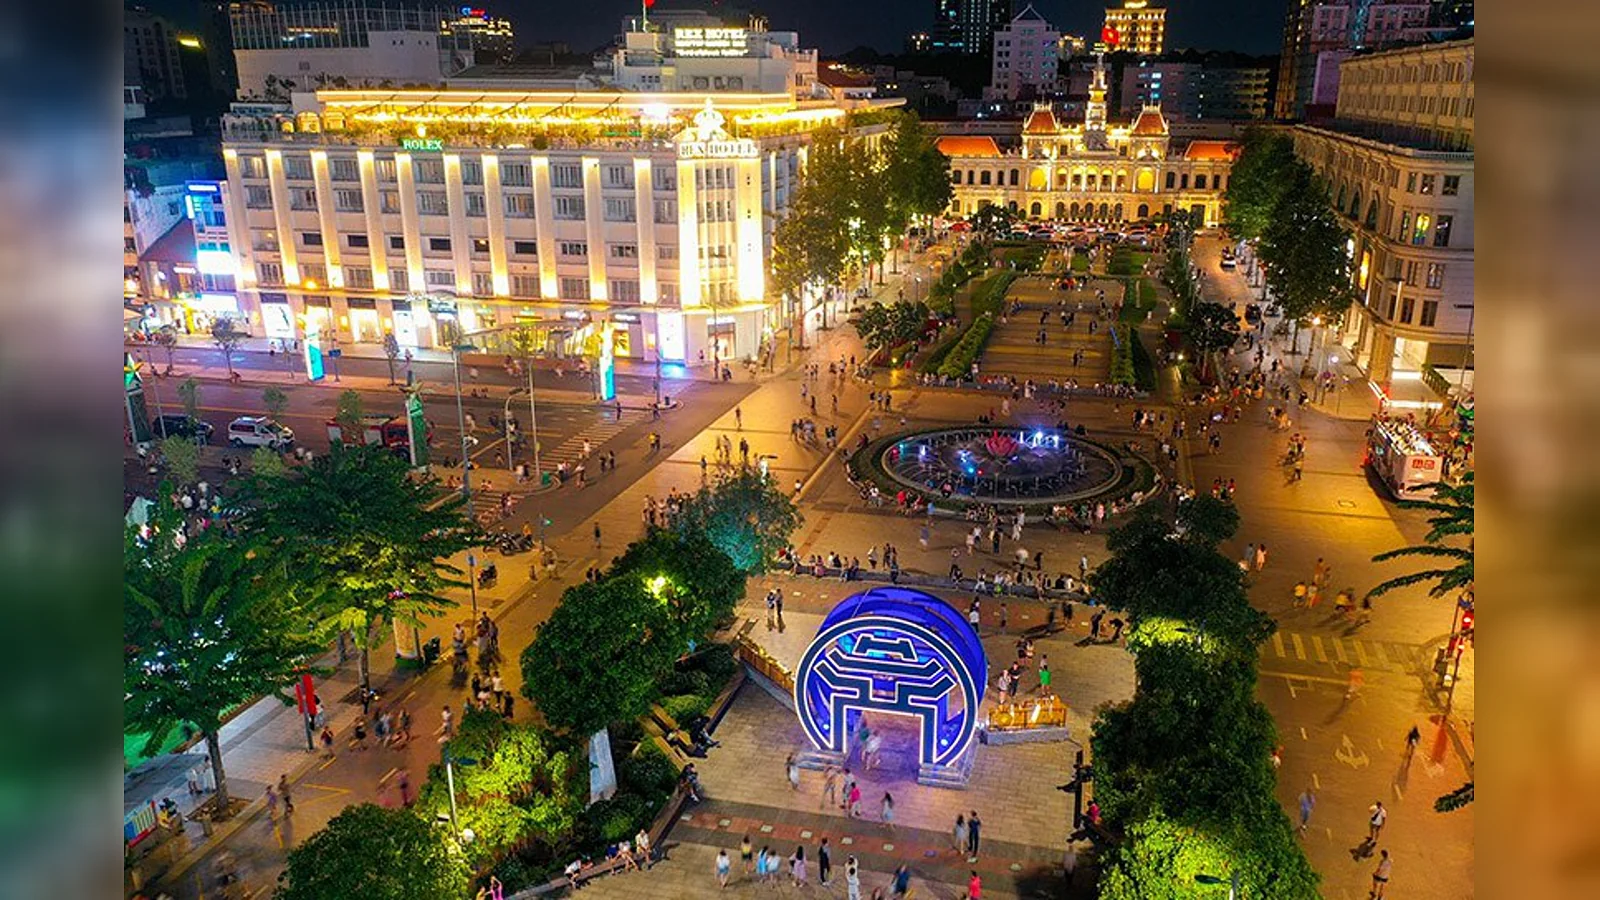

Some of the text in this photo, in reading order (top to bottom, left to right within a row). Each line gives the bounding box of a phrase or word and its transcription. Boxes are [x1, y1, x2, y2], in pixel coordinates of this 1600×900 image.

[705, 28, 747, 39] HOTEL
[403, 139, 443, 150] ROLEX
[680, 141, 758, 157] REX HOTEL
